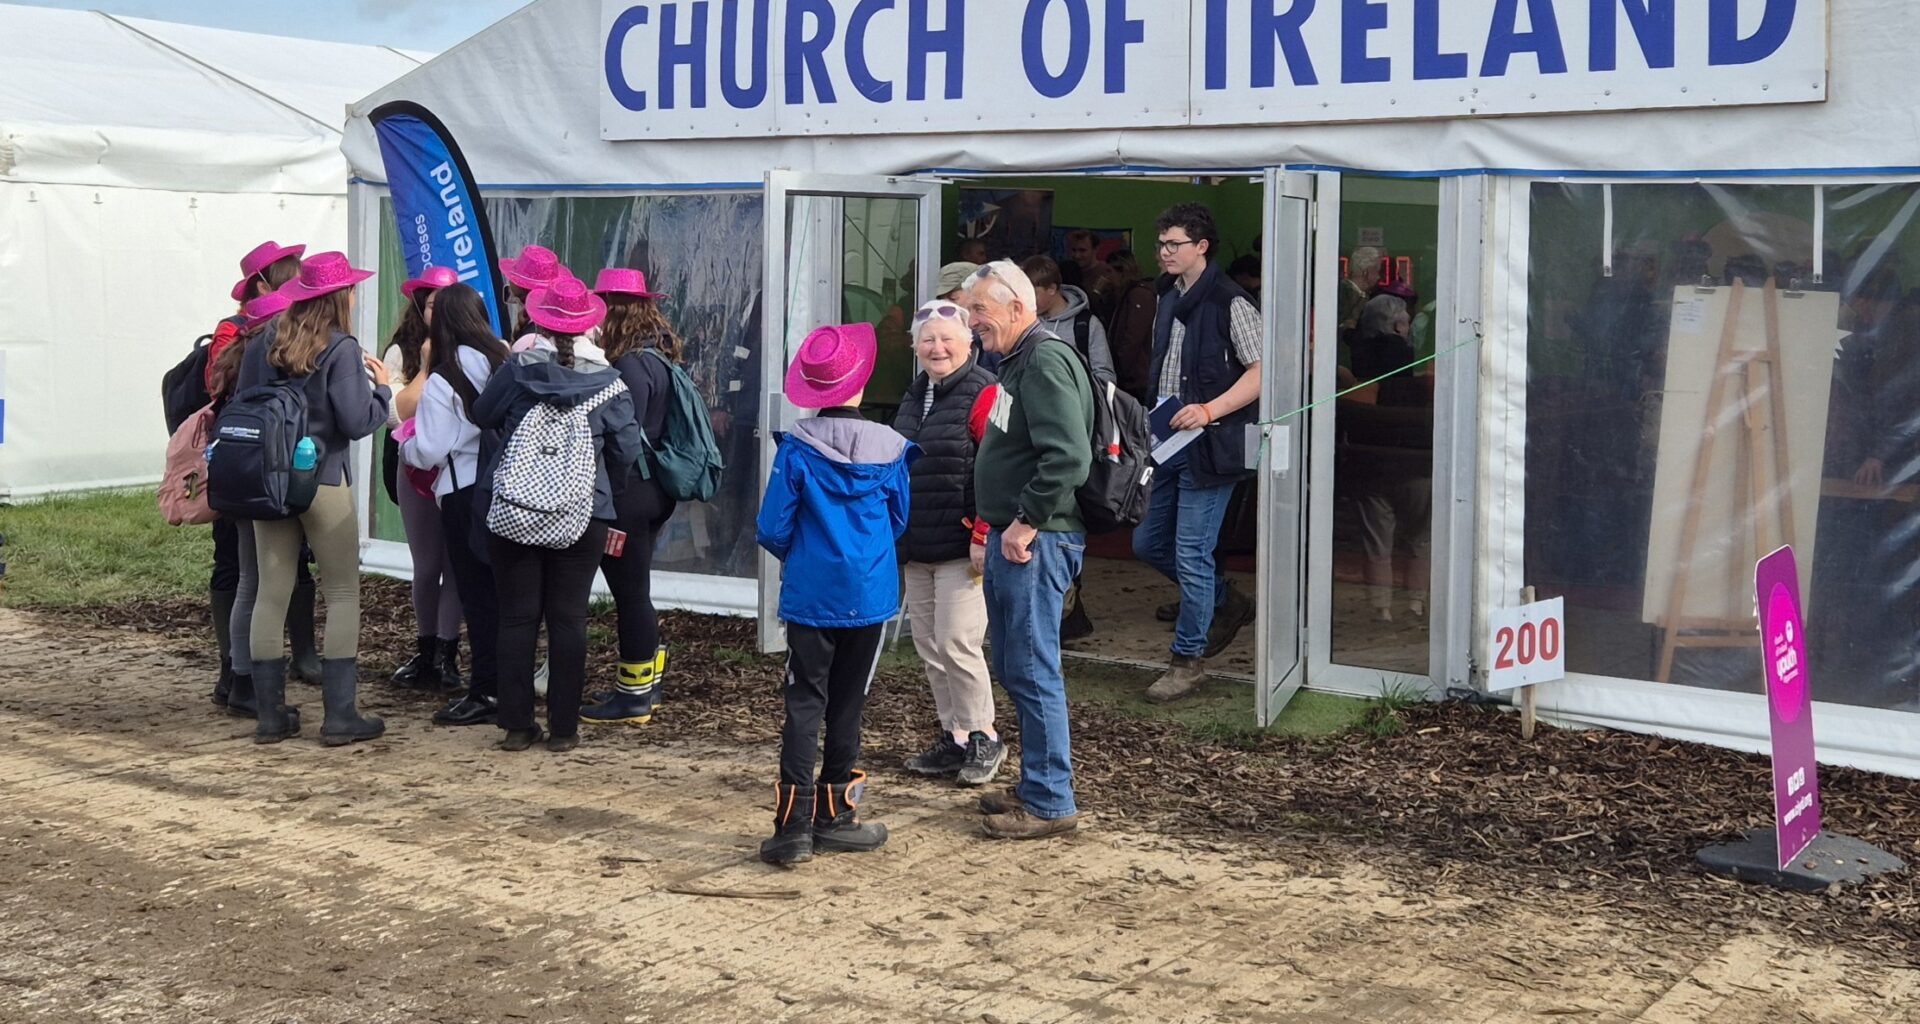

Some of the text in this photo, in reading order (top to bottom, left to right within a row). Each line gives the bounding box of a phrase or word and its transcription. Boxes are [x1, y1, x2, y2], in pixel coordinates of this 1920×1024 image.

[604, 0, 1795, 111] CHURCH OF IRELAND
[415, 213, 433, 271] oceses
[430, 161, 479, 282] Ireland
[1494, 617, 1559, 670] 200
